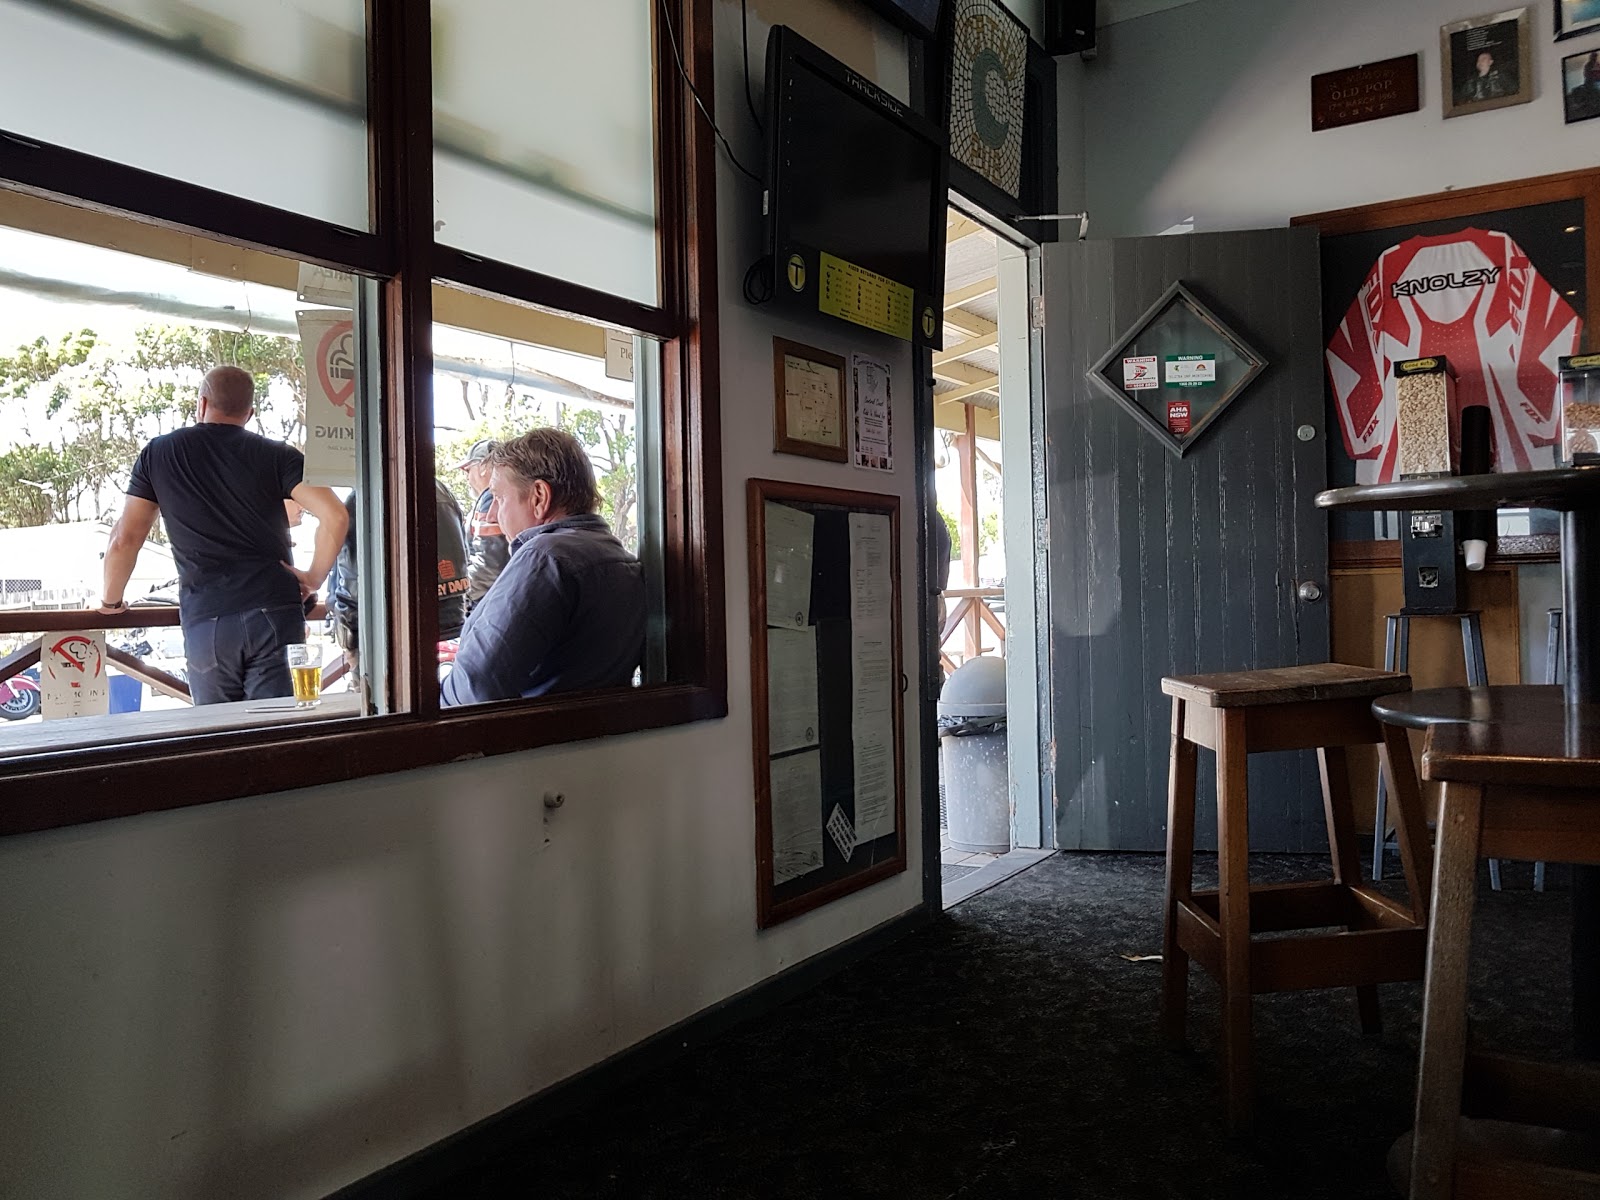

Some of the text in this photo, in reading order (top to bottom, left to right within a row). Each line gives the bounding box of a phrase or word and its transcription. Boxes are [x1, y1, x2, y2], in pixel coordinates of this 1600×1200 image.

[845, 69, 904, 118] TRACKSIDE
[1332, 80, 1393, 100] OLD POP
[790, 261, 804, 286] T
[1391, 266, 1503, 299] KNOLZY
[924, 313, 933, 333] T
[1519, 401, 1546, 424] FOX
[1361, 418, 1380, 443] FOX
